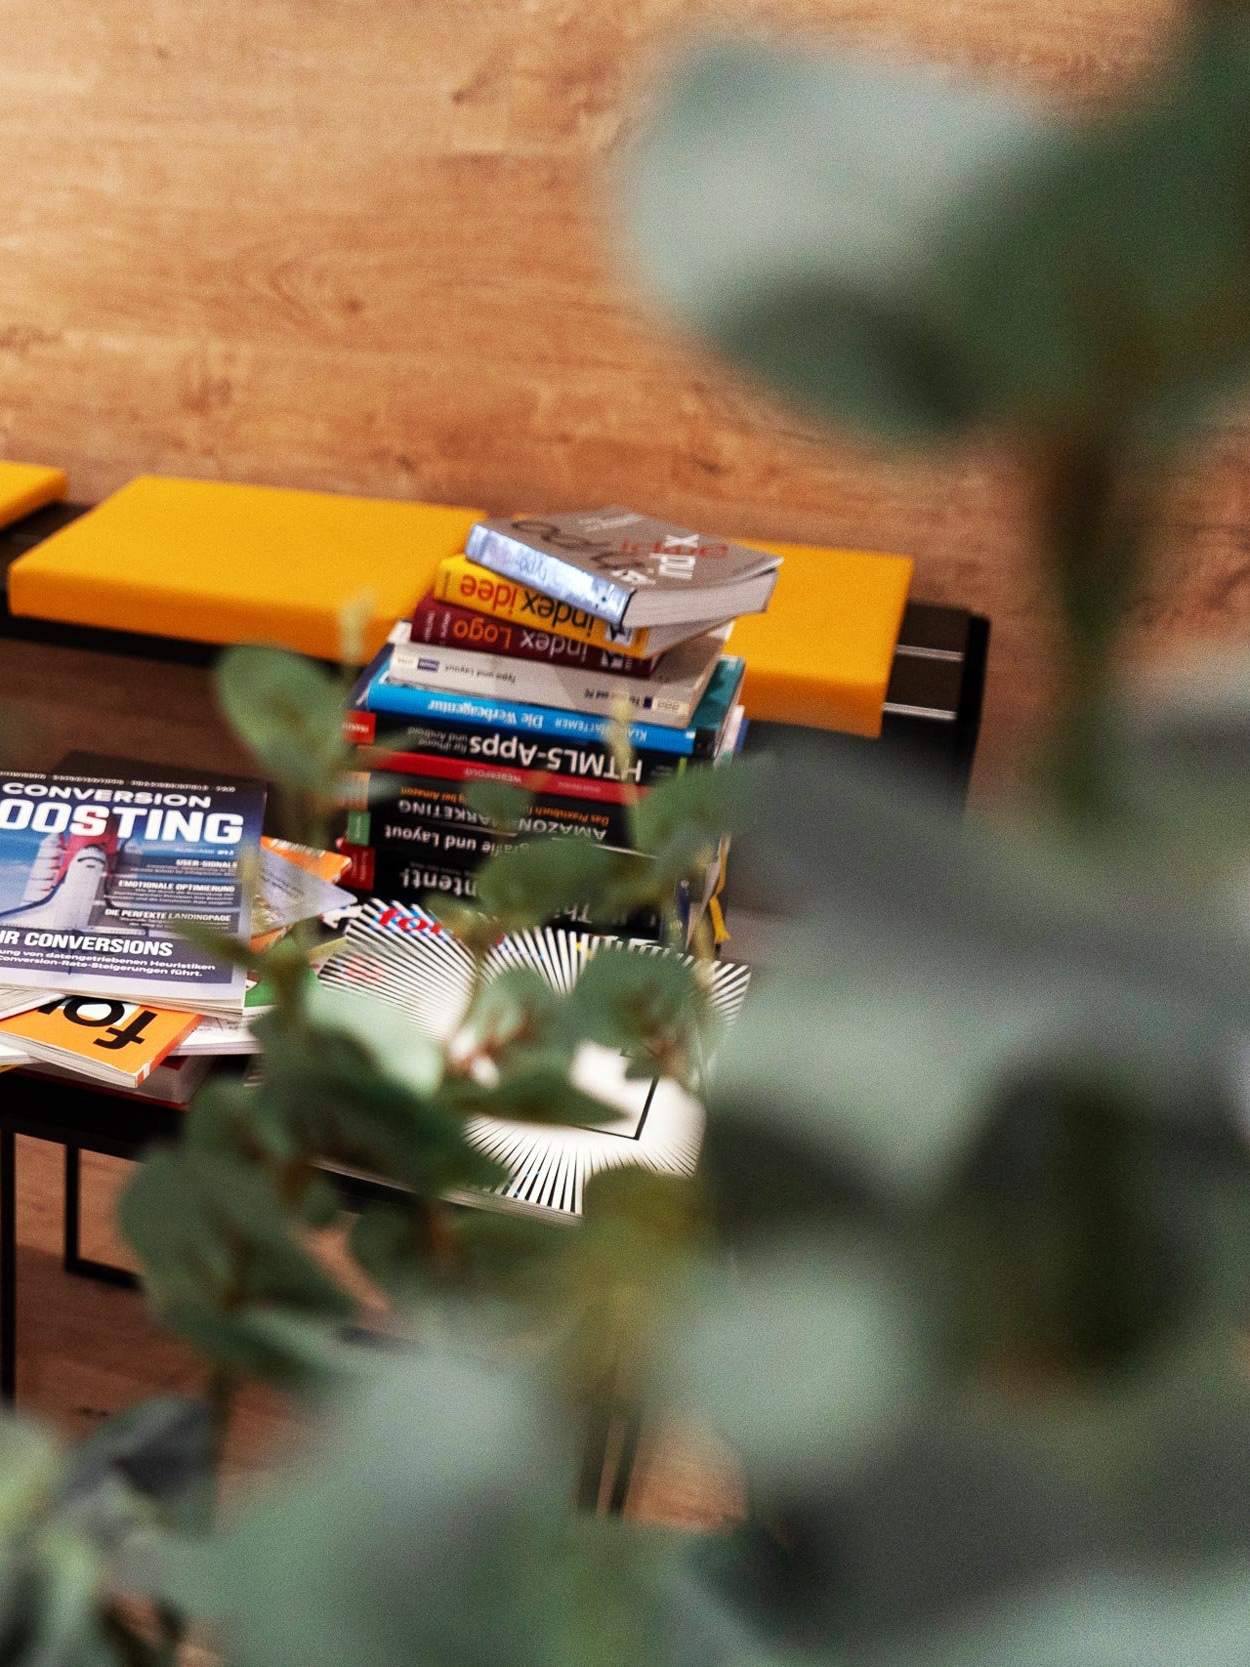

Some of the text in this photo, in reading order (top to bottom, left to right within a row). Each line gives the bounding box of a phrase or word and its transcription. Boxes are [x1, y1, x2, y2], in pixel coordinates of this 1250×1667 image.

[460, 575, 518, 615] idee
[521, 590, 595, 637] index
[453, 617, 513, 649] Logo
[520, 629, 589, 662] index
[427, 699, 518, 725] Werbeagentur
[521, 711, 544, 729] Die
[469, 733, 643, 784] HTML5-Apps
[1, 782, 212, 809] CONVERSION
[401, 786, 440, 801] Amazon
[588, 814, 610, 826] Das
[384, 824, 440, 842] Layout
[444, 834, 477, 851] und
[118, 880, 236, 893] EMOTIONALE OPTIMIERUNG
[401, 867, 478, 897] ntent!
[104, 908, 120, 917] DIE
[121, 909, 167, 920] PERFEKTE
[24, 932, 174, 957] CONVERSIONS
[45, 952, 148, 966] datengetriebenen
[149, 960, 216, 971] Heuristiken
[170, 968, 203, 977] führt.
